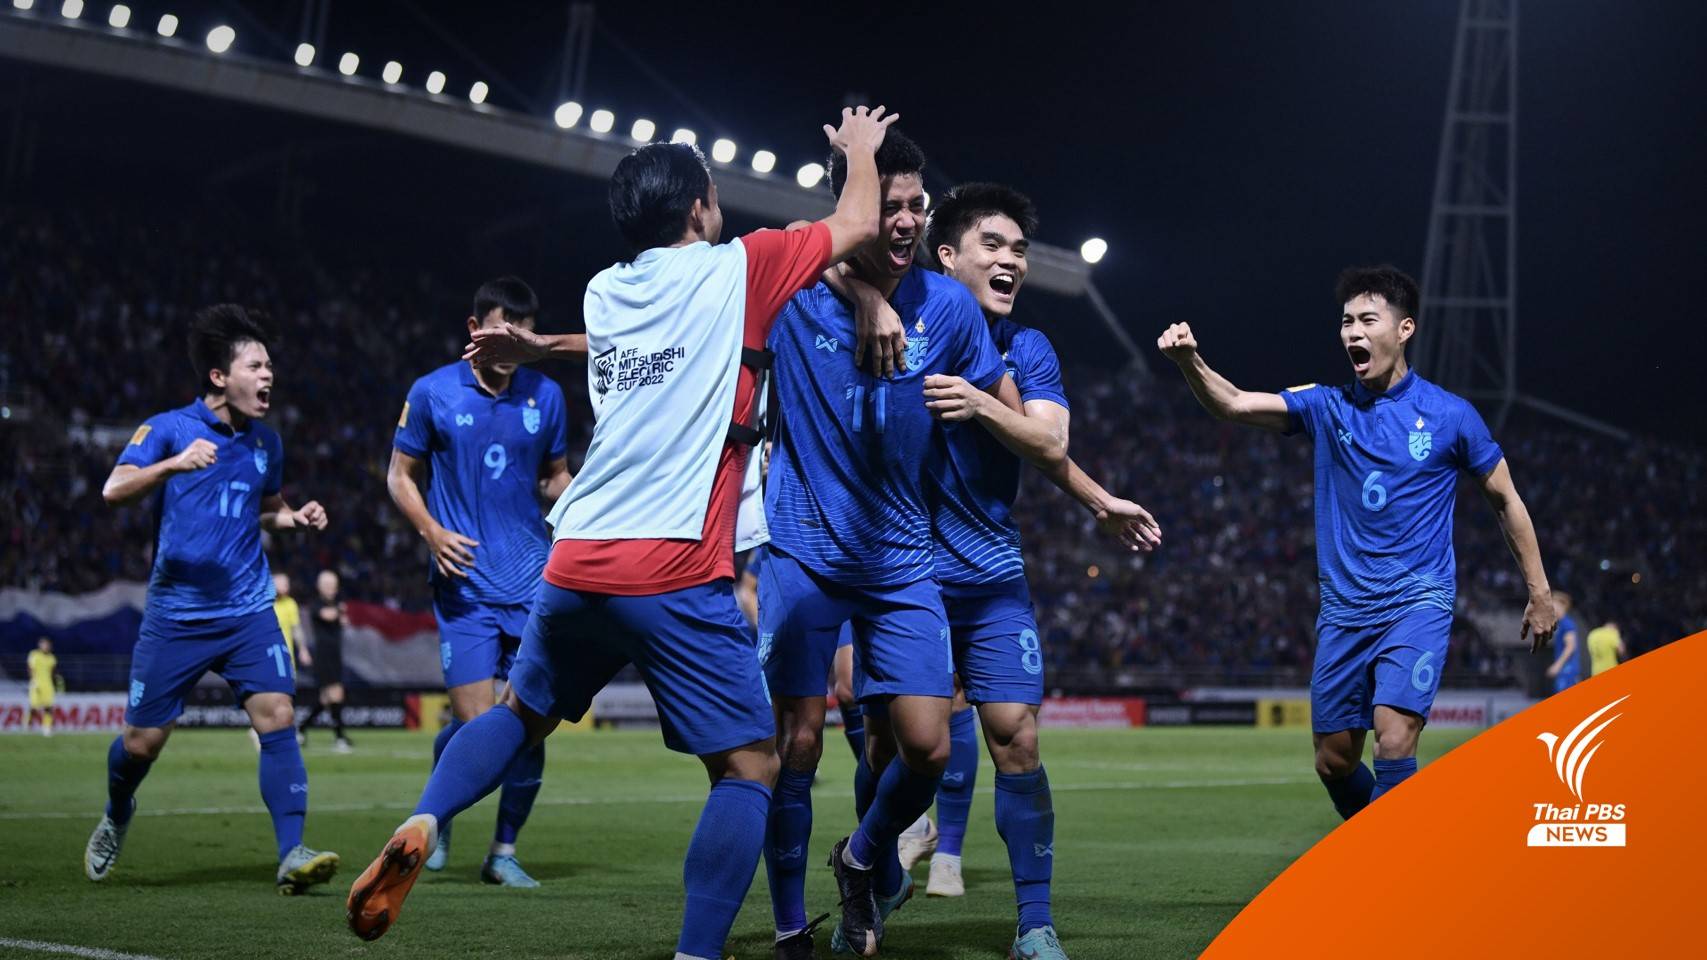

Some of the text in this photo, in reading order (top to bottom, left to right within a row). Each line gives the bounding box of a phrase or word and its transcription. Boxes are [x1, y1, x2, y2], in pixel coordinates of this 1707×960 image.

[618, 346, 685, 371] MITSUBISHI
[620, 347, 639, 360] AFF
[638, 374, 664, 387] 2022
[846, 384, 886, 433] 11
[484, 443, 507, 480] 9
[219, 480, 250, 519] 17
[1361, 470, 1387, 512] 6
[1019, 628, 1042, 675] 8
[1411, 650, 1435, 692] 6
[0, 704, 125, 729] ANMAR
